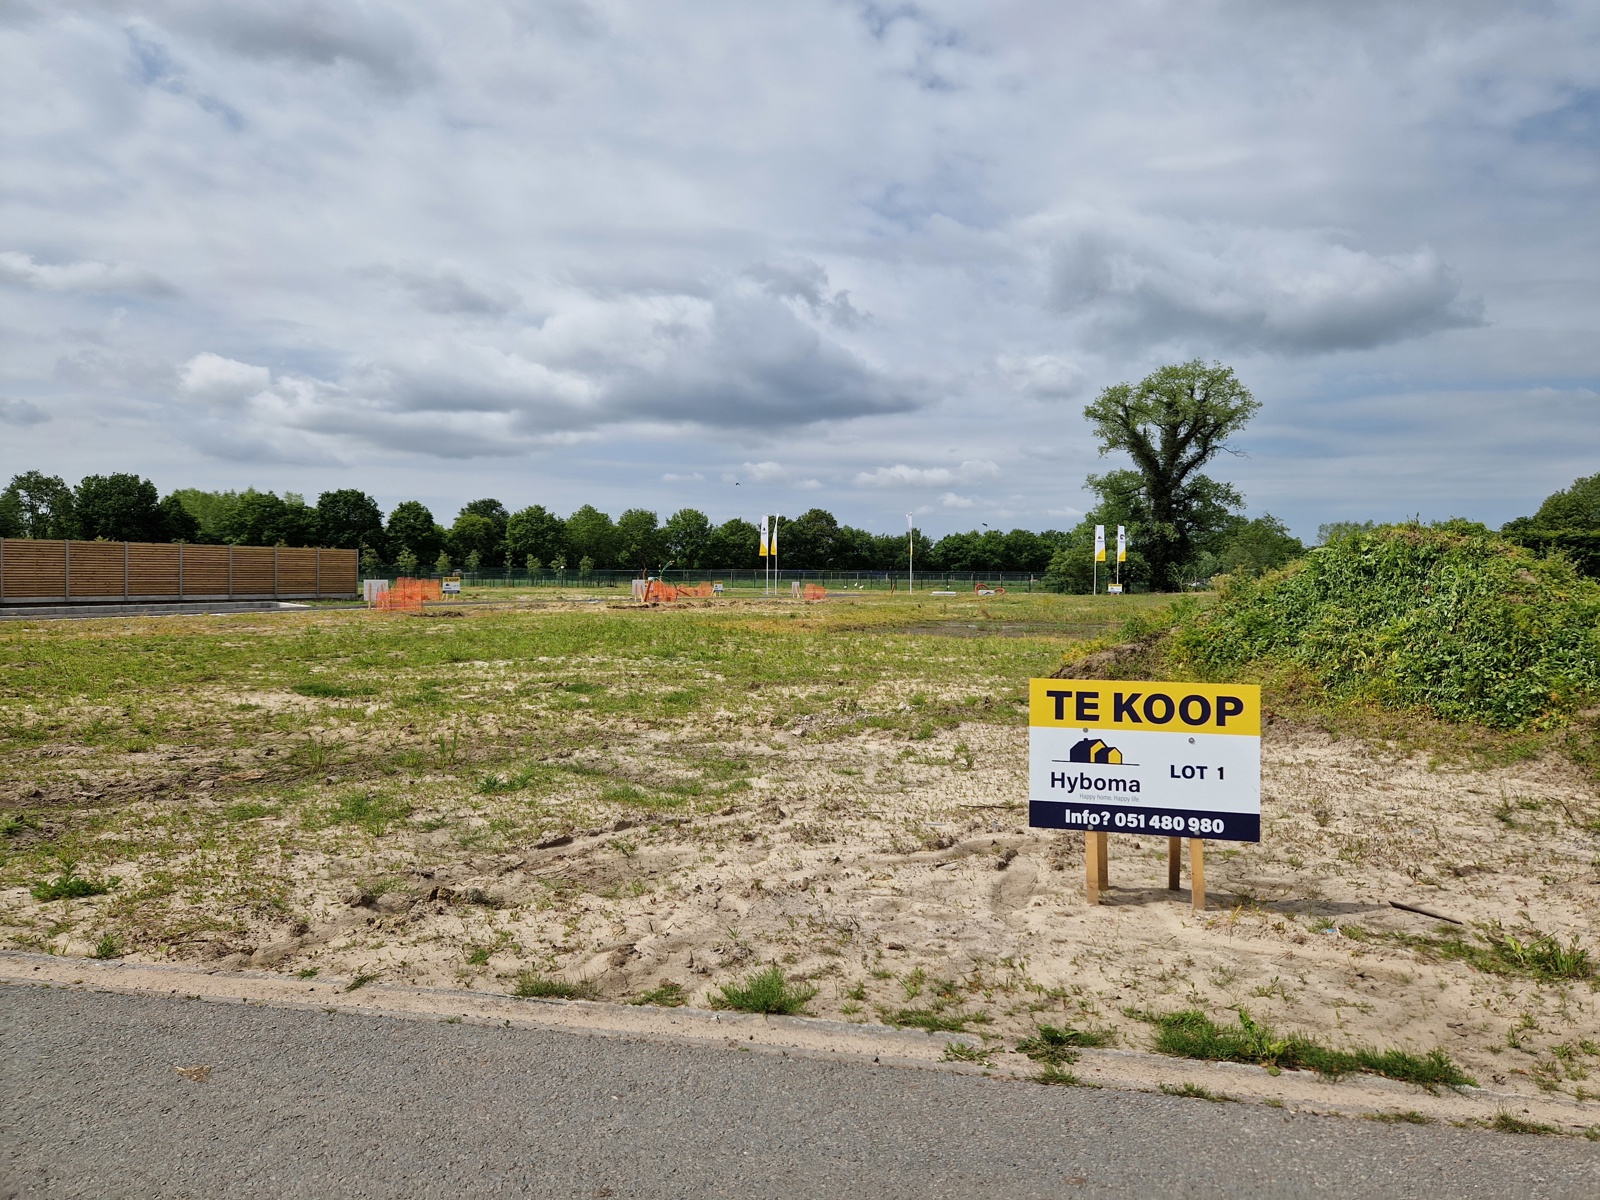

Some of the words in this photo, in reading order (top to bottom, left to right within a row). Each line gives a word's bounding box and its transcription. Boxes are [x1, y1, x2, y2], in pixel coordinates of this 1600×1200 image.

[1046, 690, 1100, 722] TE
[1113, 692, 1244, 727] KOOP
[1050, 771, 1141, 794] Hyboma
[1170, 764, 1208, 780] LOT
[1217, 766, 1224, 780] 1
[1080, 793, 1096, 801] Happy
[1097, 793, 1112, 801] home.
[1114, 795, 1131, 803] Happy
[1065, 809, 1111, 826] Info?
[1114, 812, 1145, 828] 051
[1148, 815, 1185, 831] 480
[1187, 817, 1225, 834] 980
